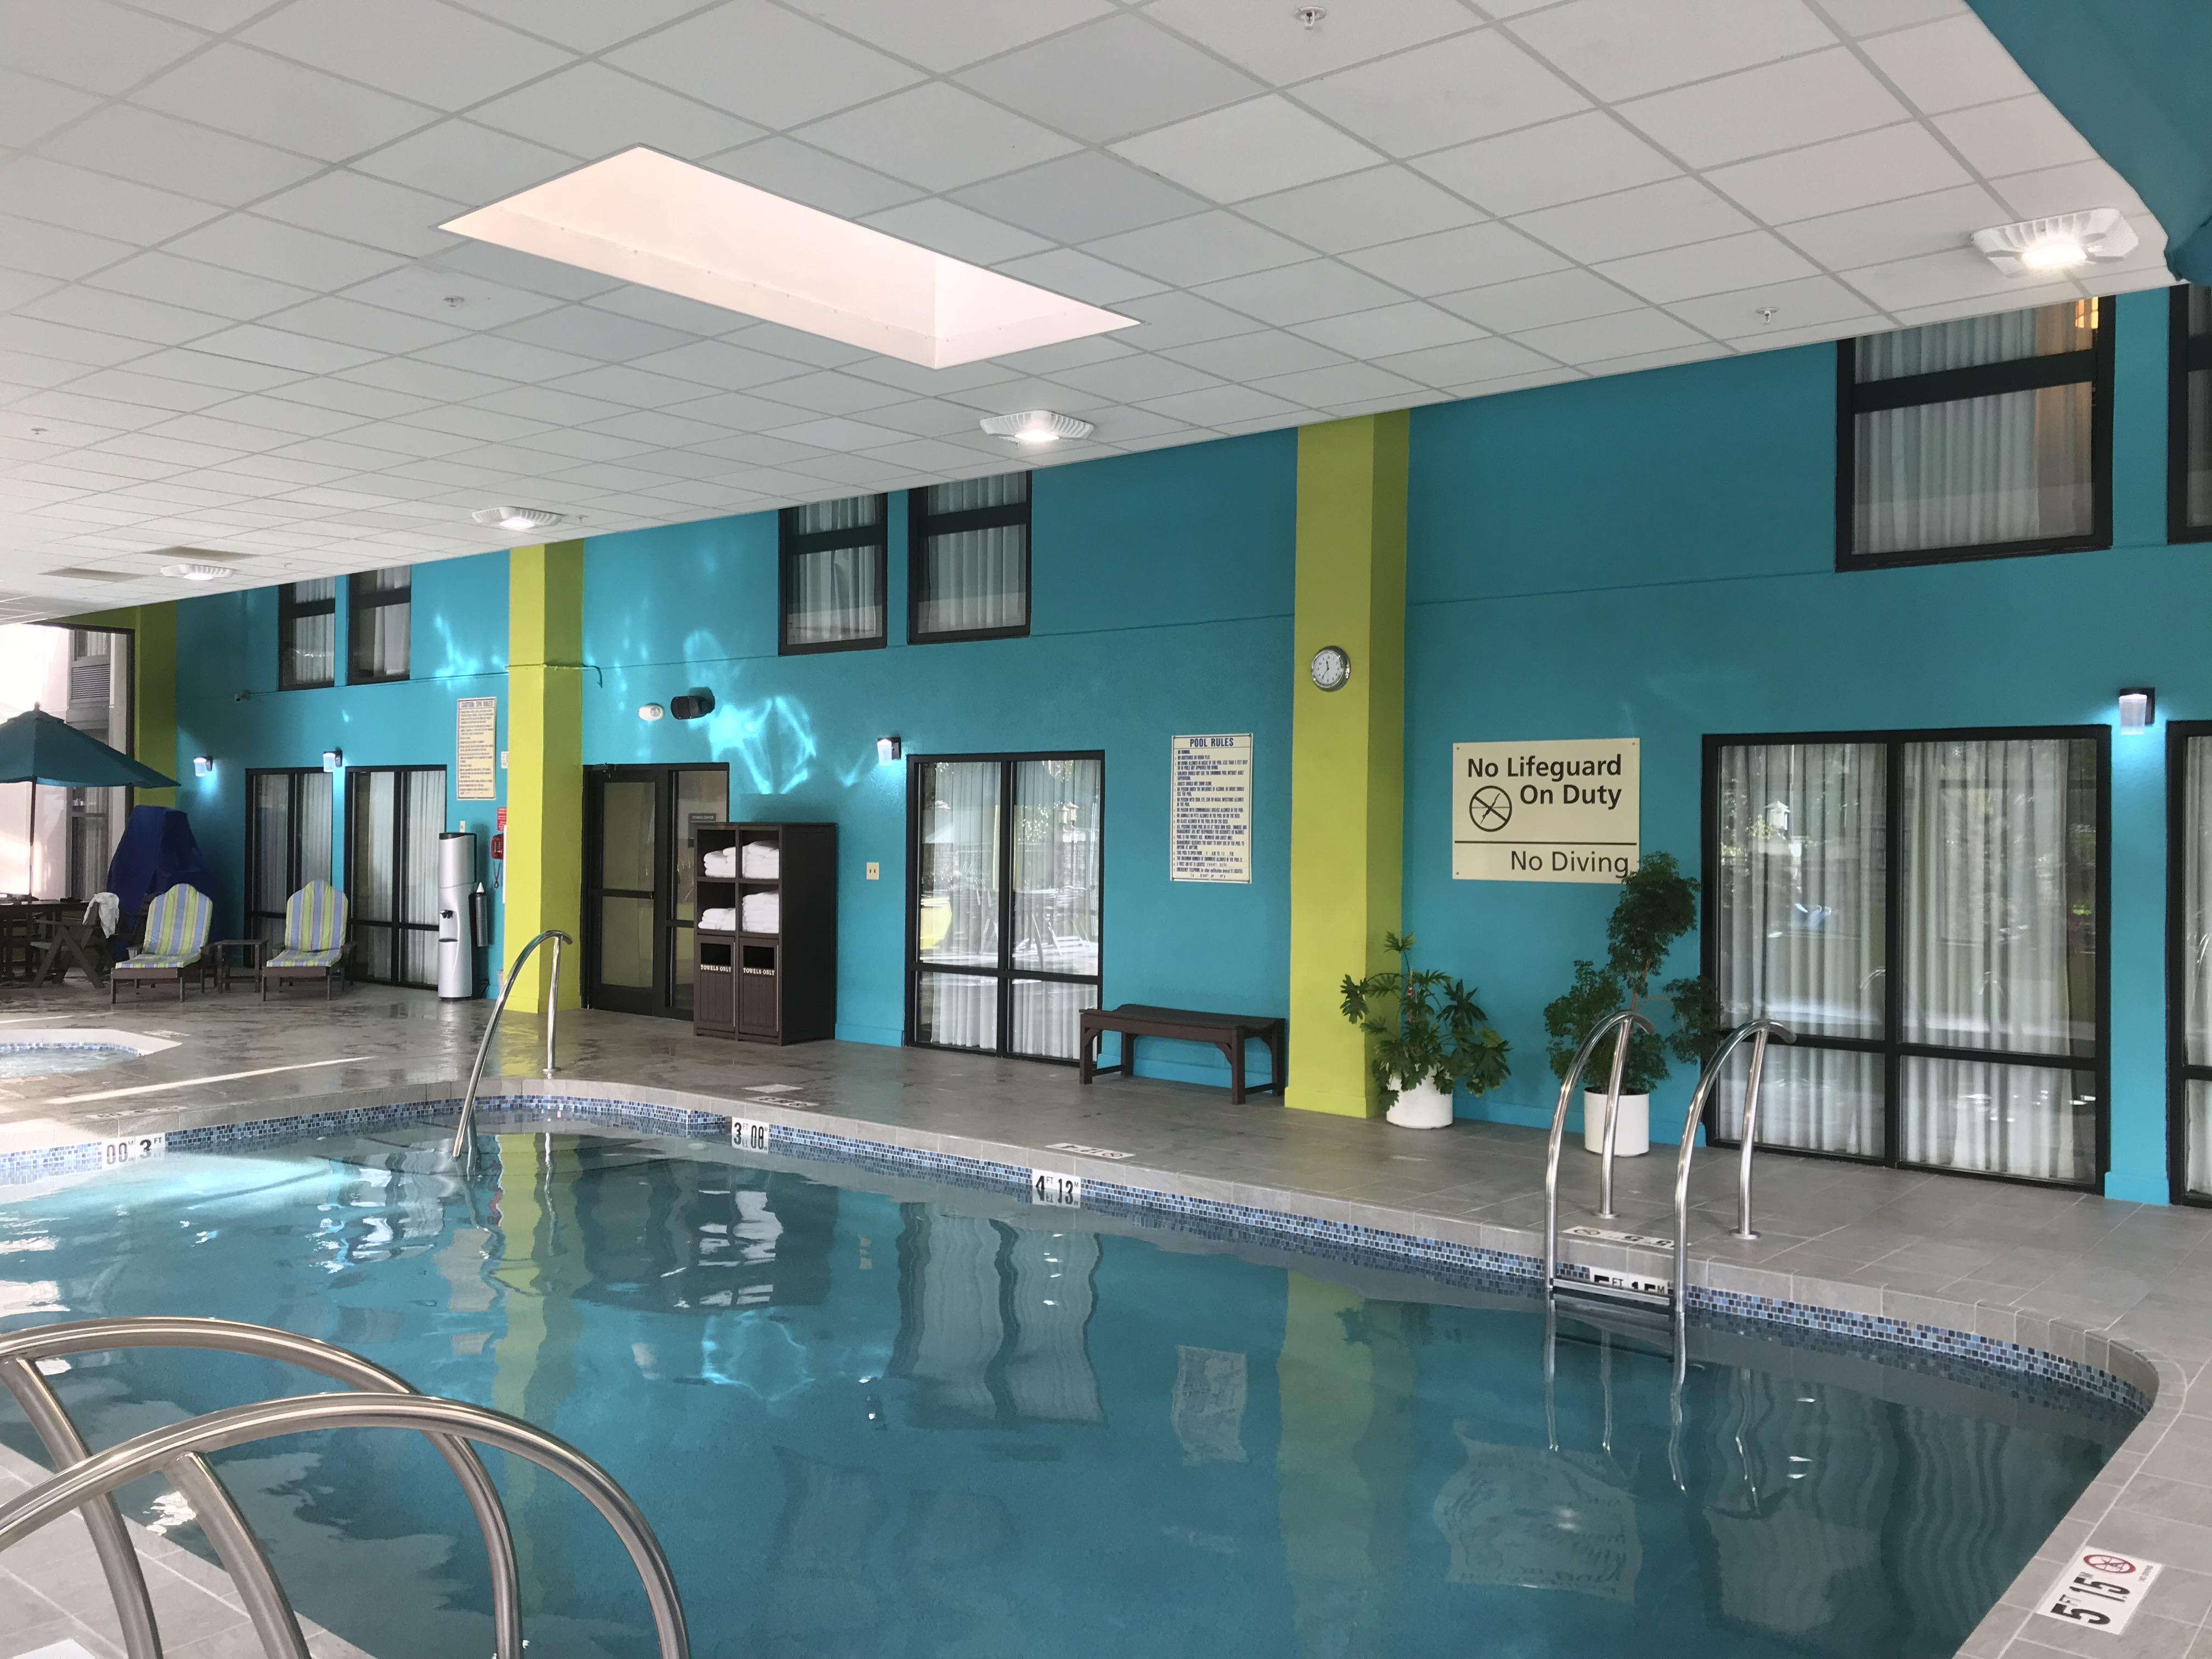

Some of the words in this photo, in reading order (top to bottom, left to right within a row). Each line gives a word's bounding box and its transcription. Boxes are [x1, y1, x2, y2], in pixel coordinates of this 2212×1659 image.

[1190, 738, 1207, 747] POOL
[1211, 738, 1233, 747] RULES
[1468, 758, 1499, 777] No
[1508, 754, 1622, 782] Lifeguard
[1520, 785, 1553, 804] On
[1564, 785, 1622, 810] Duty
[1511, 850, 1543, 871] No
[1553, 851, 1628, 879] Diving
[1046, 1176, 1053, 1185] FT
[2050, 1603, 2111, 1625] 5
